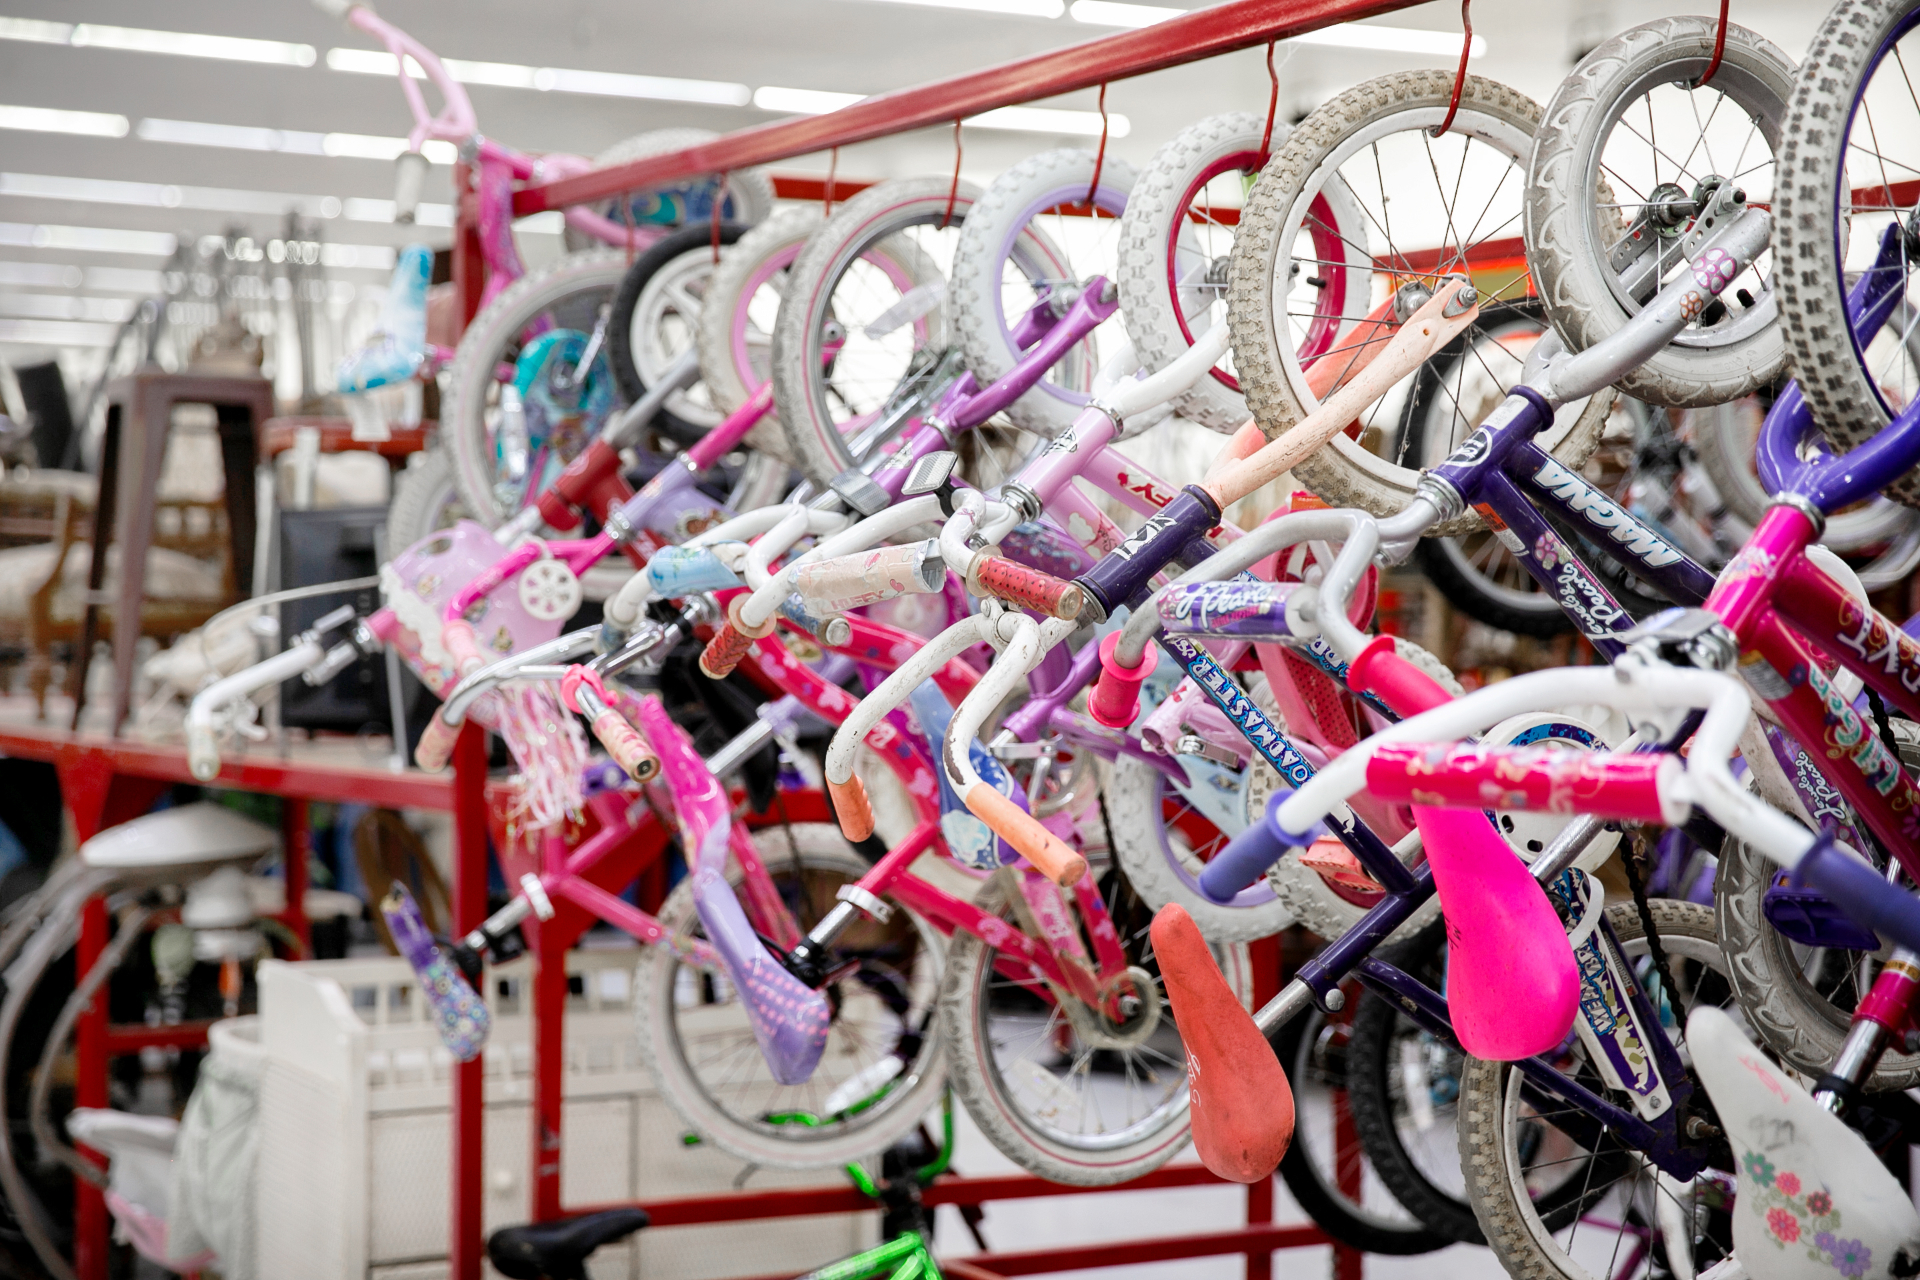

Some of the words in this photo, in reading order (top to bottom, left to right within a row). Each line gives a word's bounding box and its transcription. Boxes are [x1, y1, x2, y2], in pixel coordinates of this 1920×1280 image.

[1532, 458, 1683, 568] MAGNA
[1558, 562, 1624, 626] Pearls
[1192, 651, 1320, 790] OADMASTER
[1808, 658, 1864, 746] Gem
[1798, 750, 1840, 803] Pearls
[1798, 776, 1847, 820] Jewels
[1738, 1053, 1792, 1105] NEXT
